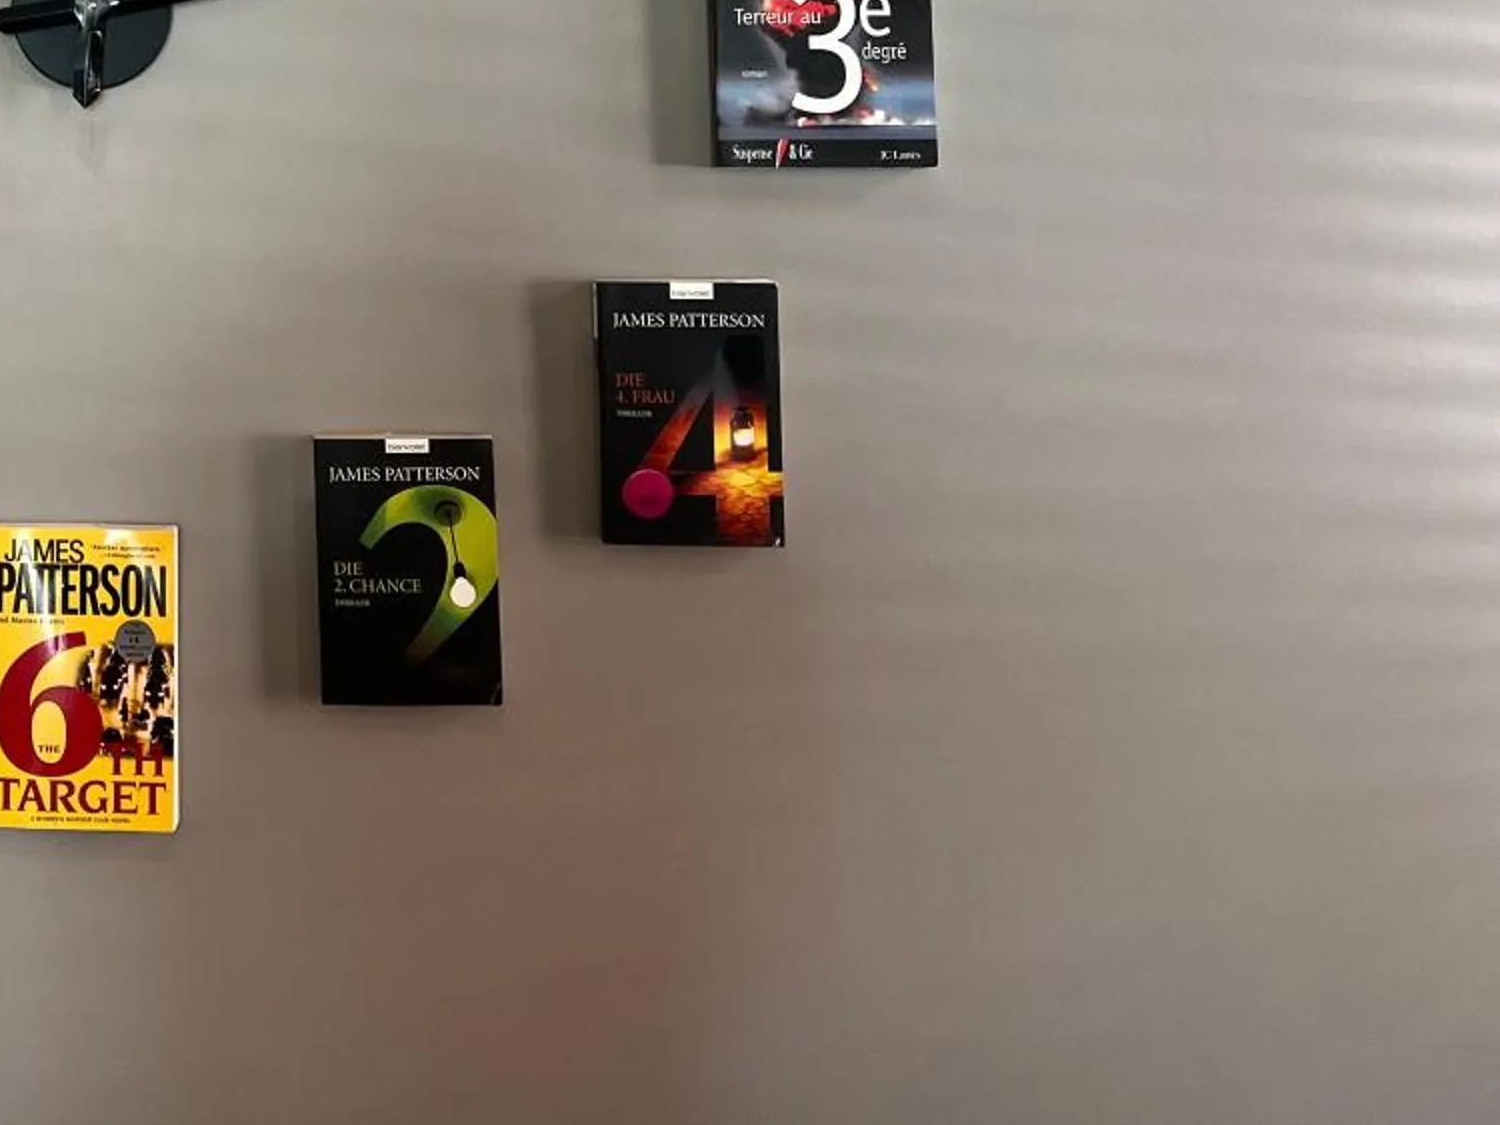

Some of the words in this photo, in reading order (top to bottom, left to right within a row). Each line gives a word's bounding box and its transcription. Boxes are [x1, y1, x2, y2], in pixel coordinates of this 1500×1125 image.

[734, 8, 793, 25] Terreur
[800, 12, 821, 25] au
[862, 41, 907, 64] degré
[613, 313, 665, 330] JAMES
[669, 312, 765, 328] PATTERSON
[616, 373, 645, 387] DIE
[632, 390, 675, 404] FRAU
[329, 467, 381, 482] JAMES
[385, 466, 481, 481] PATTERSON
[4, 538, 85, 564] JAMES
[334, 561, 364, 576] DIE
[350, 578, 422, 593] CHANCE
[38, 745, 60, 753] THE
